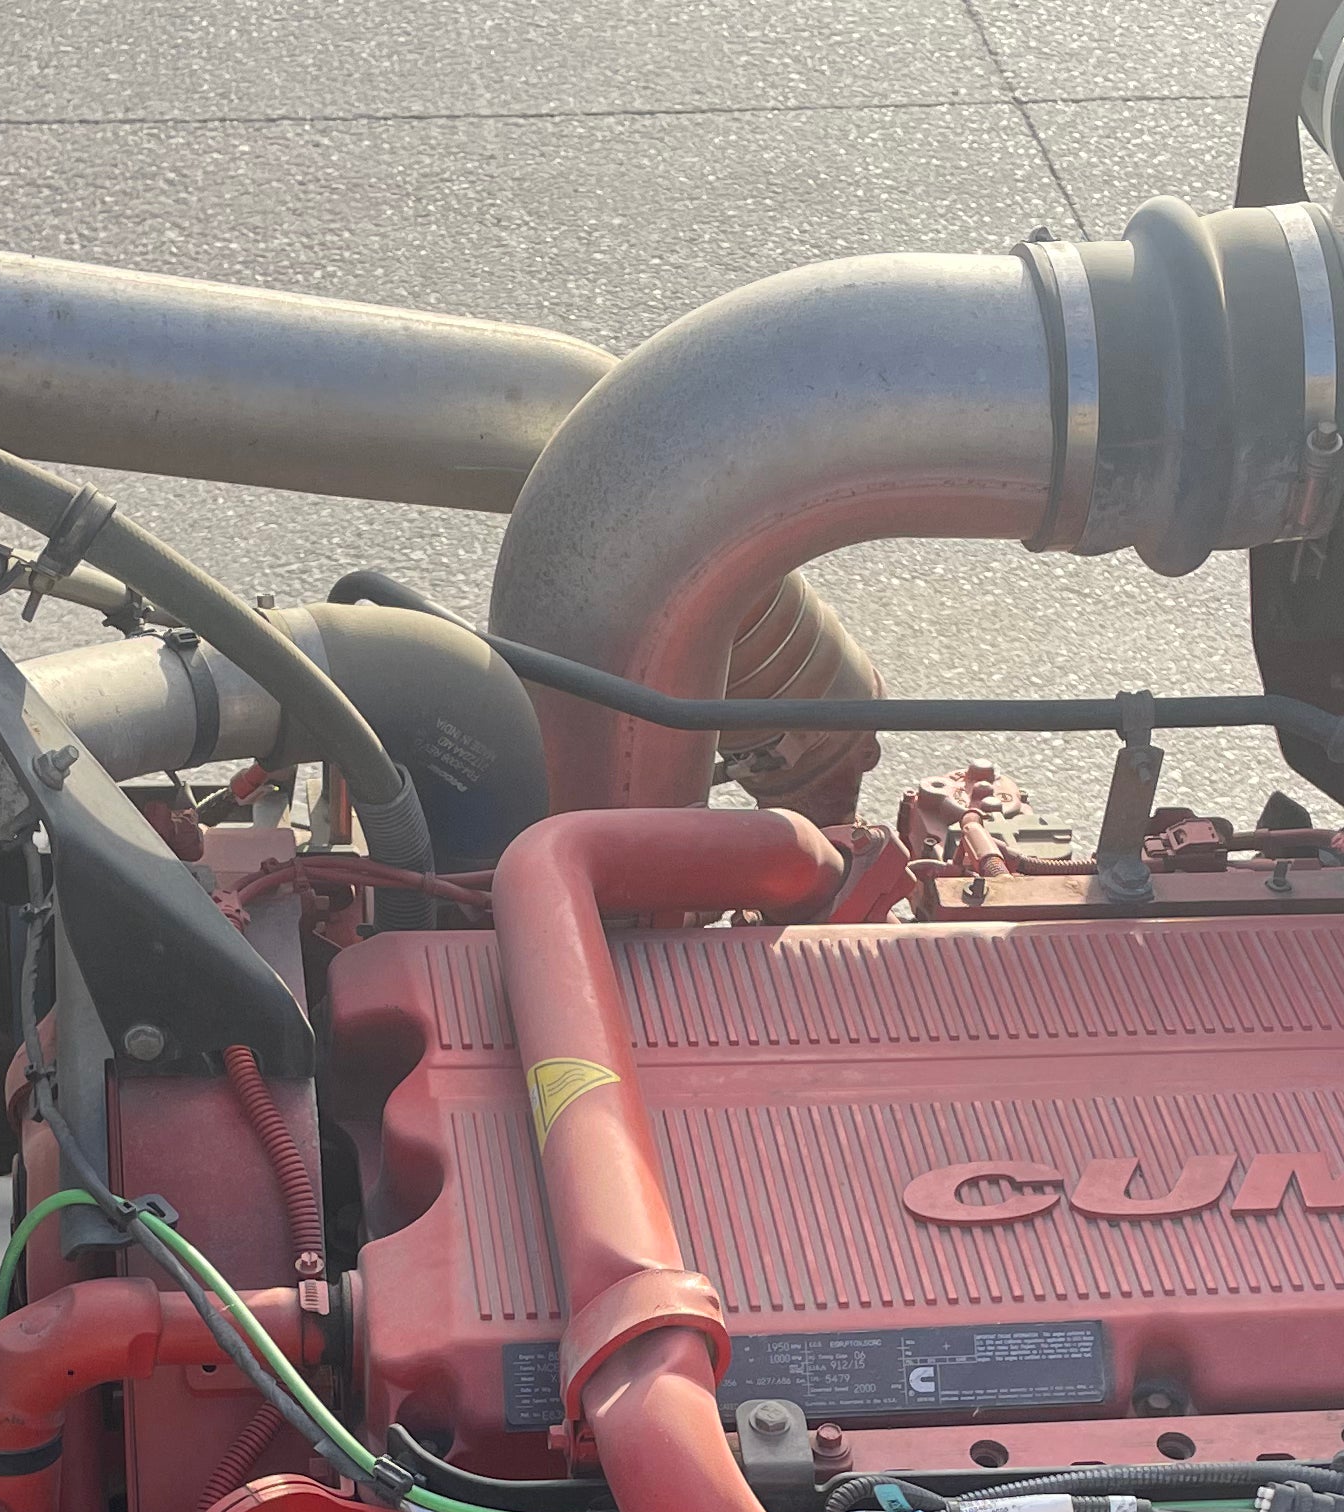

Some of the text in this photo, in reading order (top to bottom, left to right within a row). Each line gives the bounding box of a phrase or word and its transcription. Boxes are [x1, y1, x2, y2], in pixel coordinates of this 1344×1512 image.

[437, 718, 461, 738] INDIA
[767, 1343, 790, 1353] 1950
[769, 1354, 790, 1364] 1000
[830, 1360, 865, 1370] 912/15
[825, 1374, 851, 1384] 5479
[853, 1383, 877, 1394] 2000
